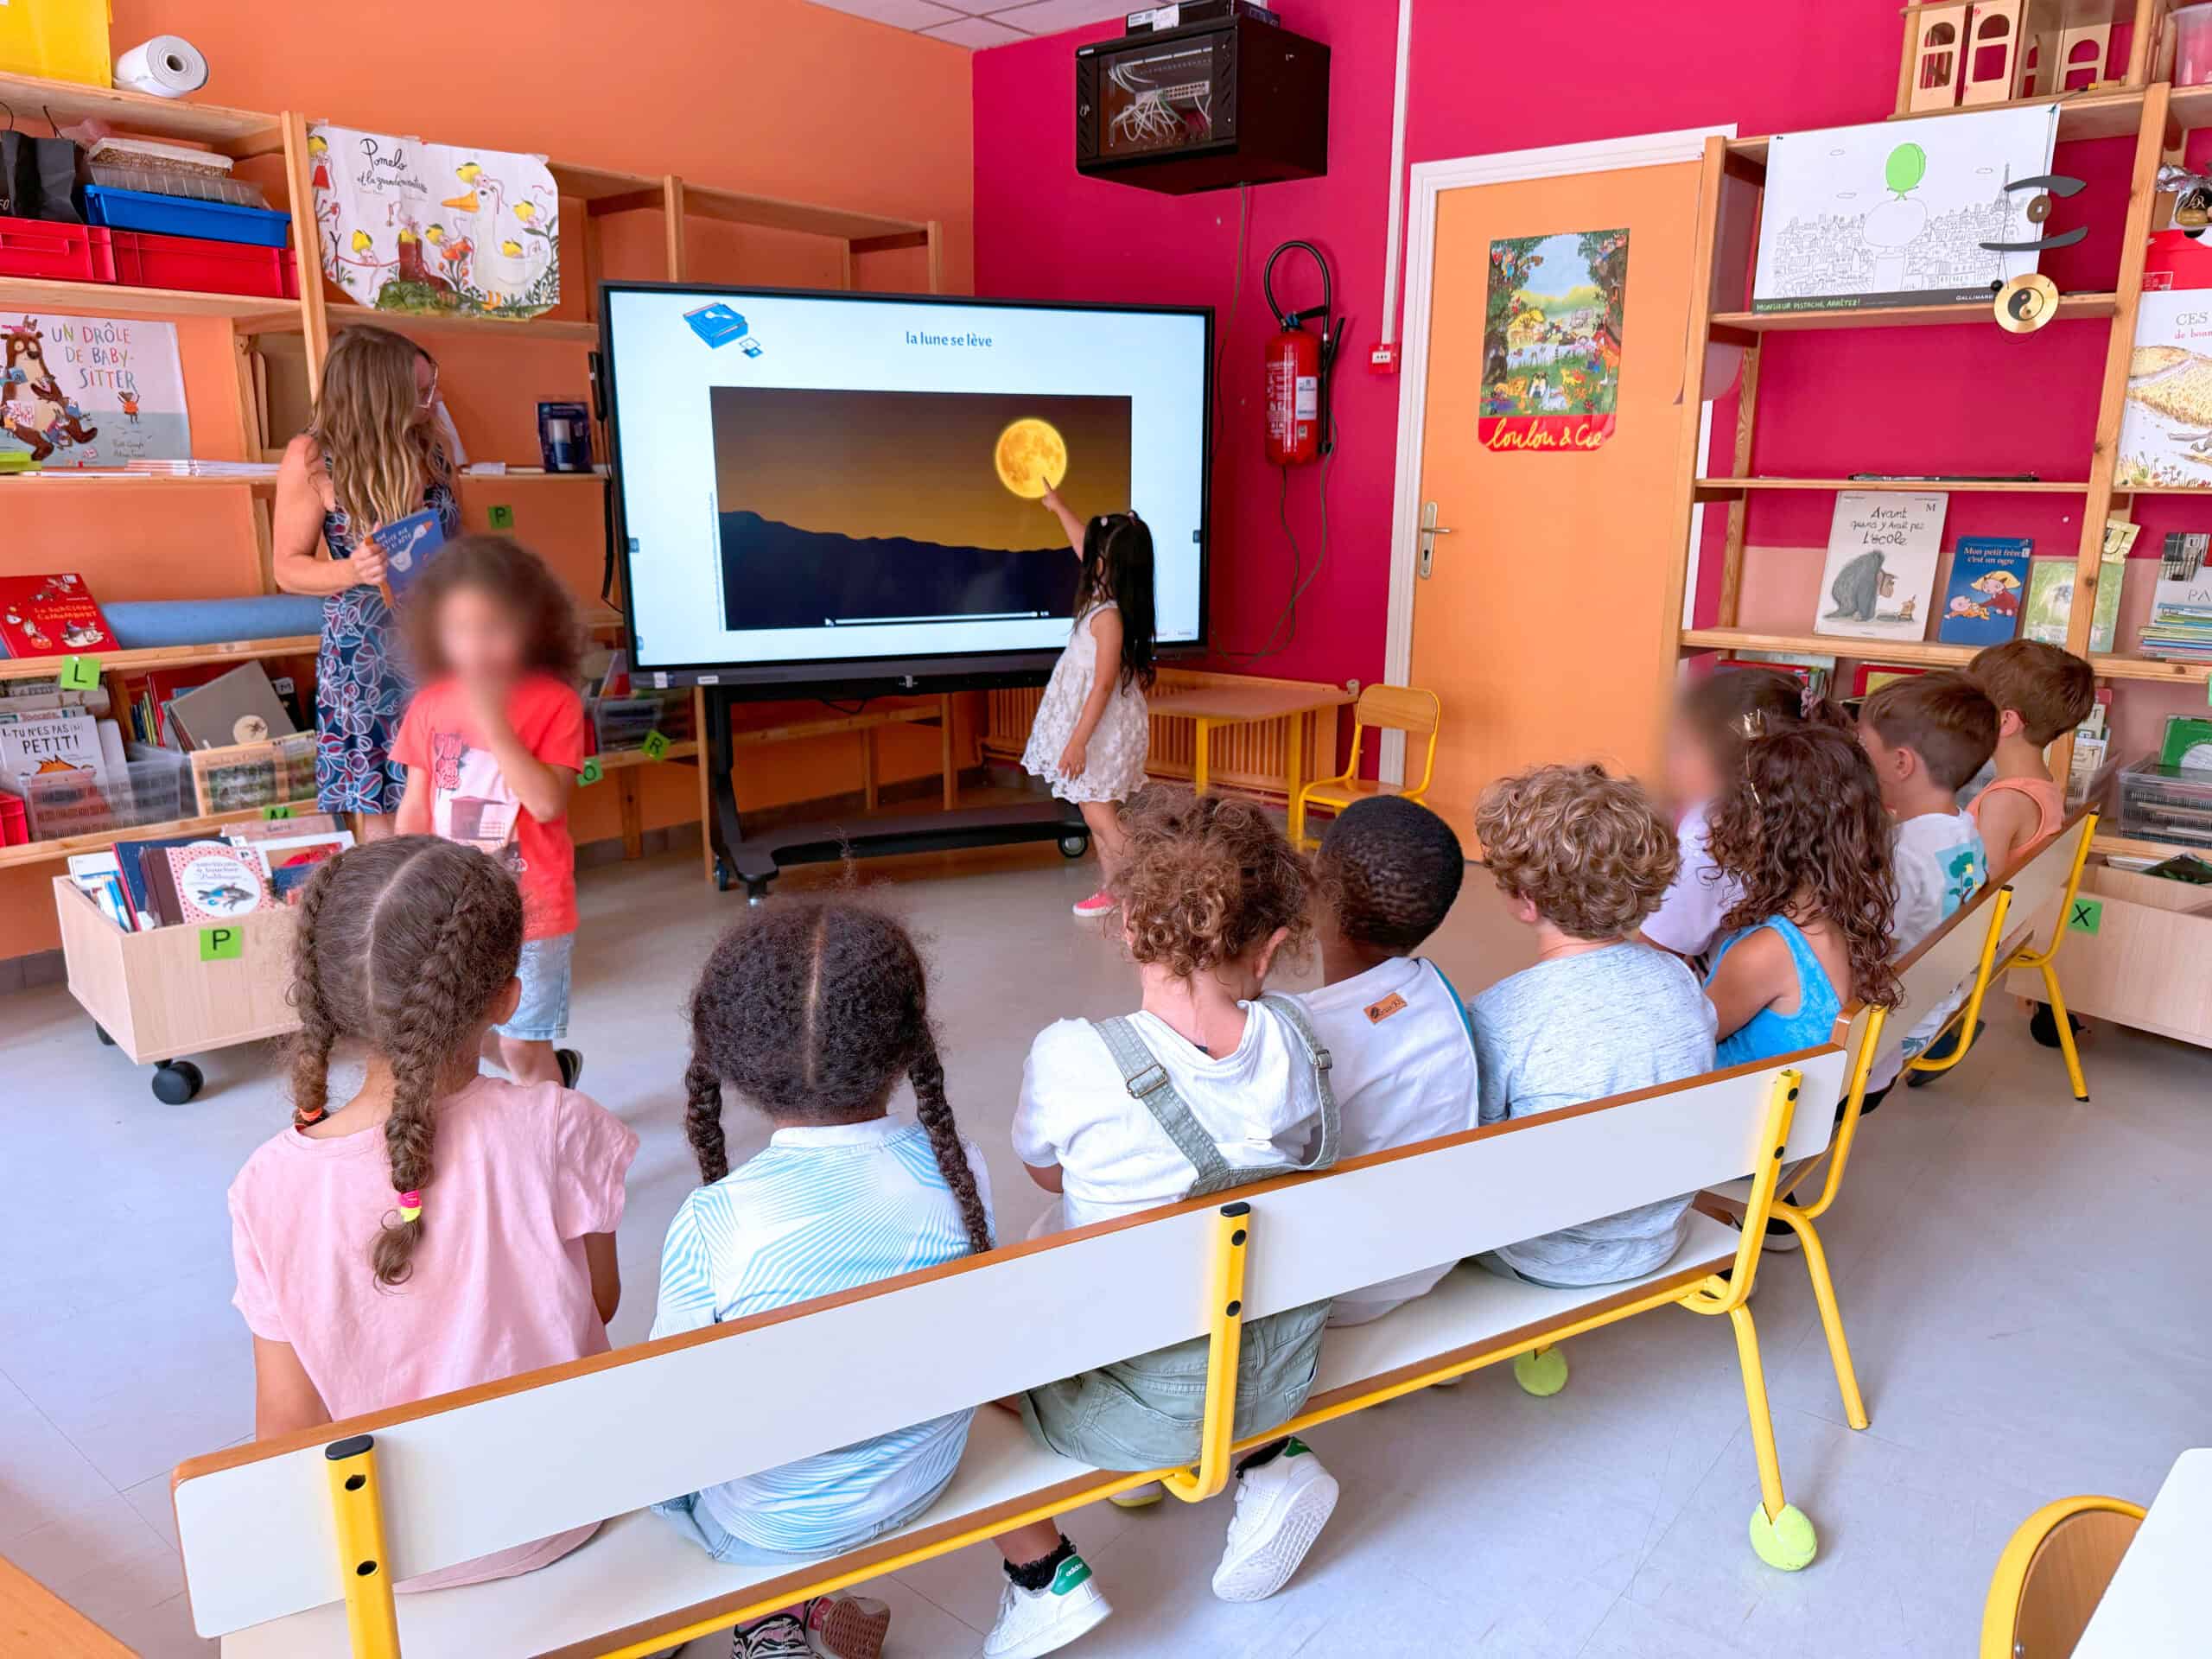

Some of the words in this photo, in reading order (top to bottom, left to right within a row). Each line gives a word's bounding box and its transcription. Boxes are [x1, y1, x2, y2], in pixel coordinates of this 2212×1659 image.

[359, 137, 407, 171] Pomelo
[2176, 311, 2209, 325] CES
[52, 322, 74, 342] UN
[83, 321, 131, 345] DRÔLE
[906, 331, 918, 345] la
[920, 331, 949, 346] lune
[950, 335, 964, 346] se
[966, 332, 993, 346] lève
[65, 346, 84, 363] DE
[1559, 426, 1571, 447] &
[1574, 423, 1602, 448] Cie
[495, 506, 506, 524] P
[1870, 505, 1908, 519] Avant
[1963, 547, 1982, 556] Mon
[1983, 548, 2002, 557] petit
[74, 664, 88, 683] L
[52, 724, 69, 734] PAS
[584, 766, 596, 781] O
[2072, 903, 2092, 926] X
[212, 929, 231, 950] P
